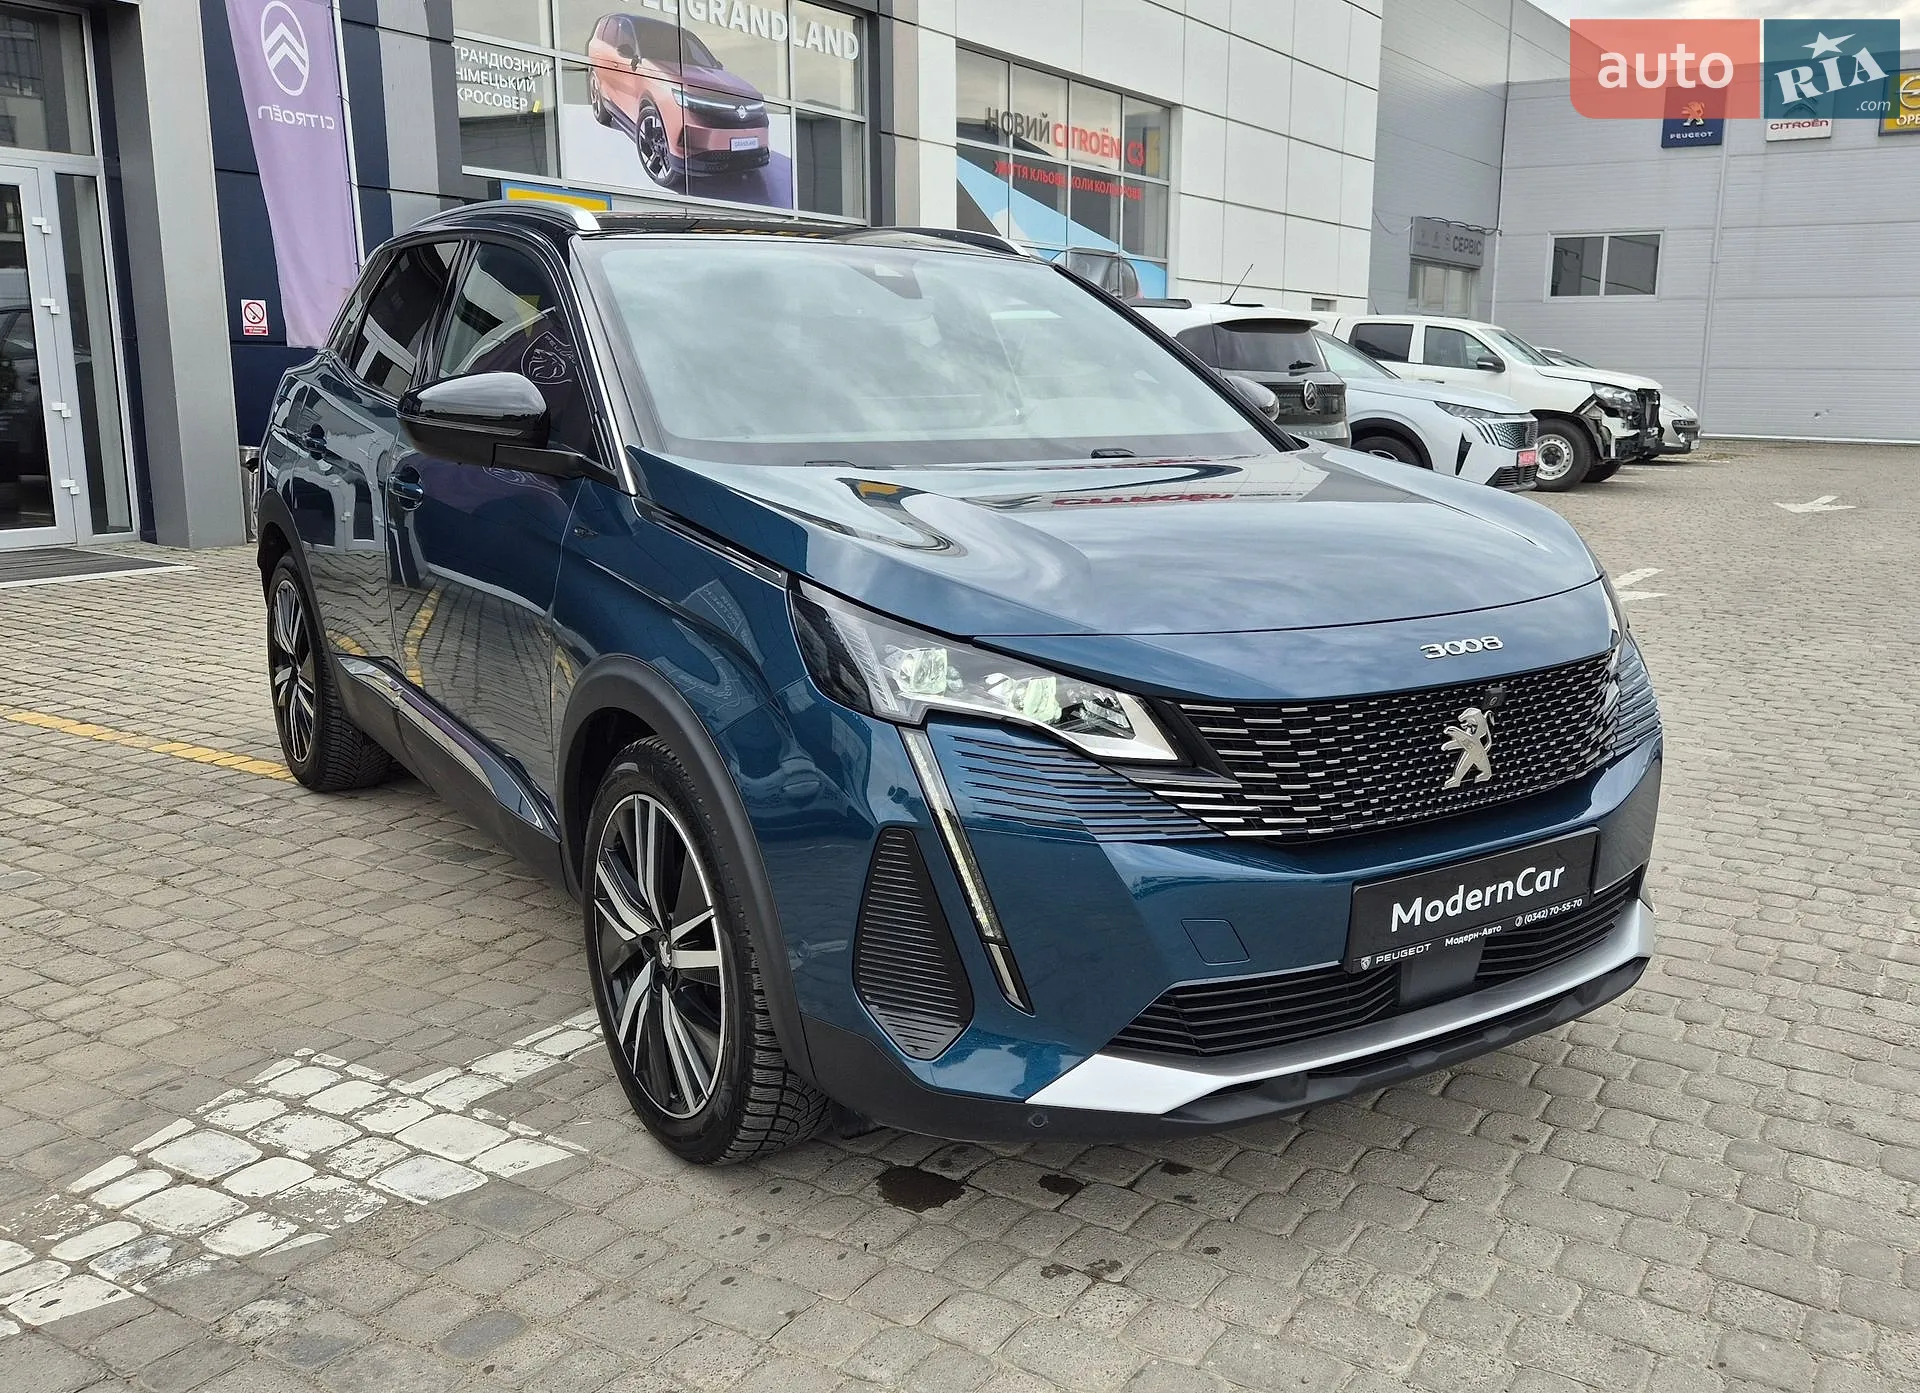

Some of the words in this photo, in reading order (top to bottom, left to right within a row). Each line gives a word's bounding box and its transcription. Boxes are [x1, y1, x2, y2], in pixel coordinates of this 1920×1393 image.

[685, 0, 860, 60] GRANDLAND
[984, 107, 1050, 144] НОВИЙ
[1053, 123, 1122, 159] CITROËN
[1670, 131, 1713, 139] PEUGEOT
[1452, 235, 1481, 256] СЕРВІС
[1420, 636, 1503, 659] 3008
[1391, 866, 1565, 932] ModernCar
[1445, 925, 1502, 947] Модерн-Авто
[1524, 908, 1548, 925] (0342)
[1549, 898, 1583, 915] 70-55-70
[1376, 943, 1432, 964] PEUGEOT
